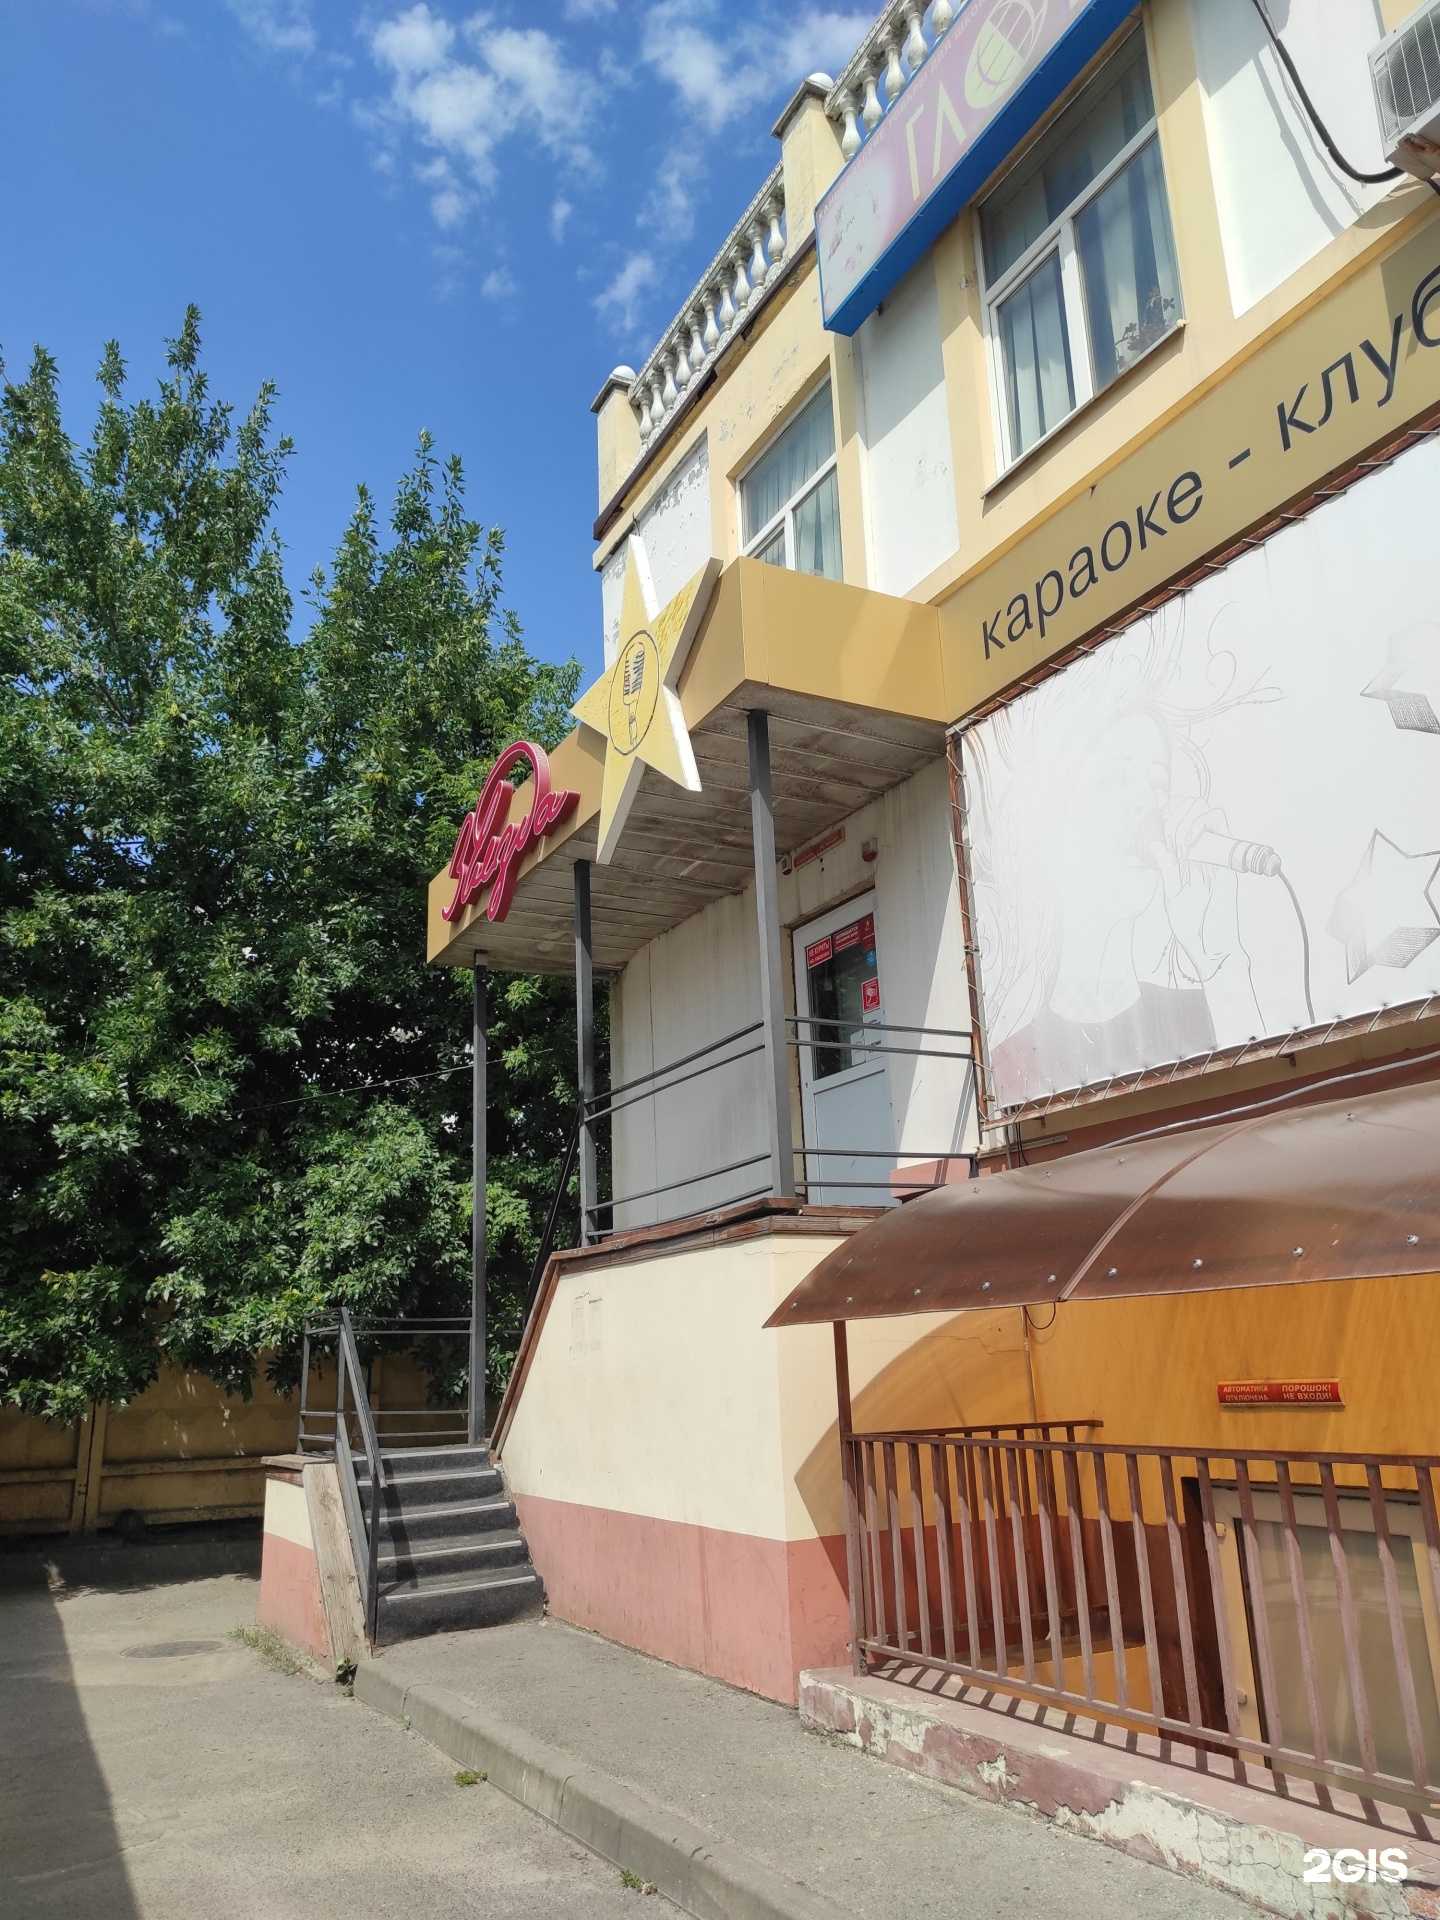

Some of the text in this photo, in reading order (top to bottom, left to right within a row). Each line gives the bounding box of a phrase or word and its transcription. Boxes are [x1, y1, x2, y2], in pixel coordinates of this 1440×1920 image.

[981, 470, 1202, 661] караоке
[1223, 1385, 1269, 1393] АВТОМАТИКА
[1281, 1384, 1331, 1393] ПОРОШОК!
[1282, 1392, 1332, 1400] НЕ ВХОДИ!
